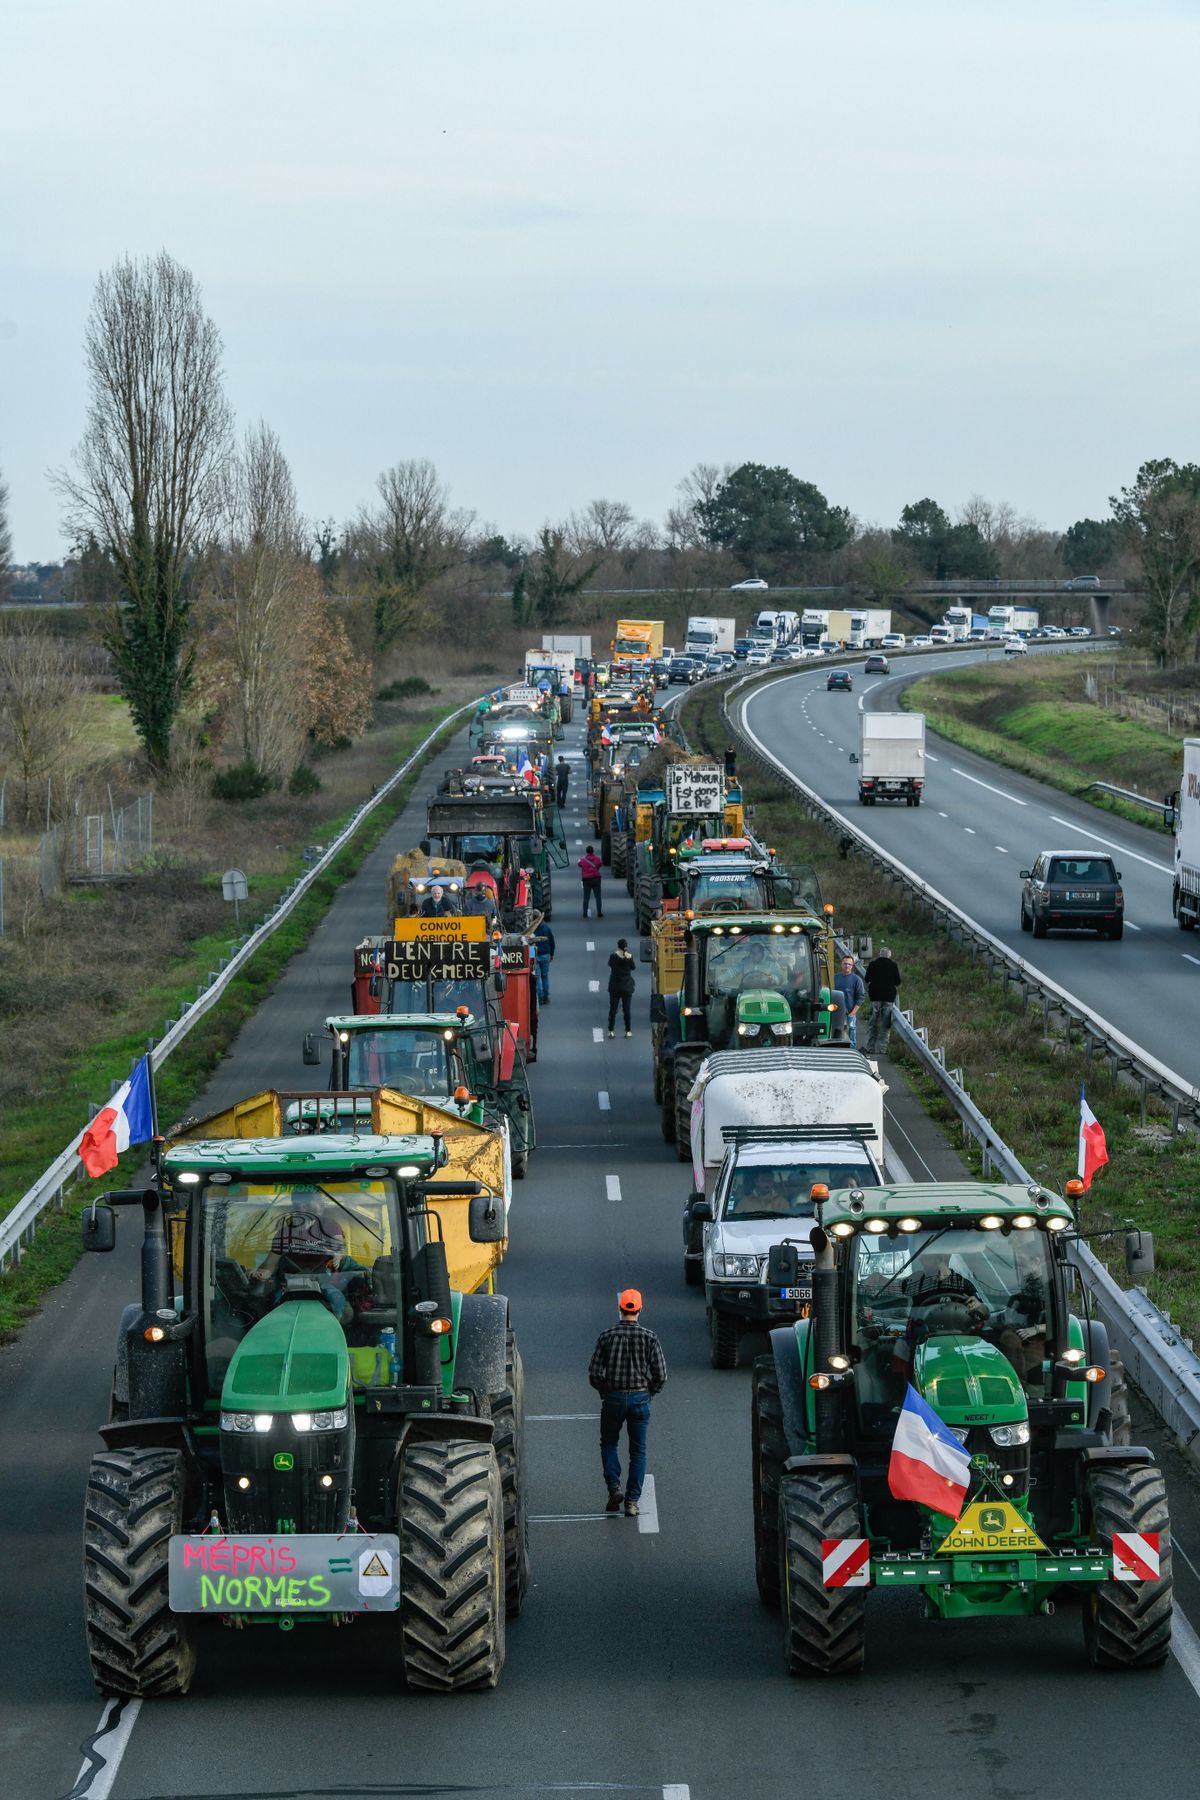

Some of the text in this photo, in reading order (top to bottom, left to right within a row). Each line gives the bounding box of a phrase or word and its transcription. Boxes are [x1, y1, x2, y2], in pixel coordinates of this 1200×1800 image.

[676, 786, 718, 798] Est dans
[677, 797, 693, 810] Le
[420, 922, 461, 931] CONVOI
[415, 933, 468, 942] AGRICOLE
[393, 942, 481, 961] L'ENTRE
[943, 1535, 1037, 1548] JOHN DEERE
[200, 1575, 332, 1607] NORMES
